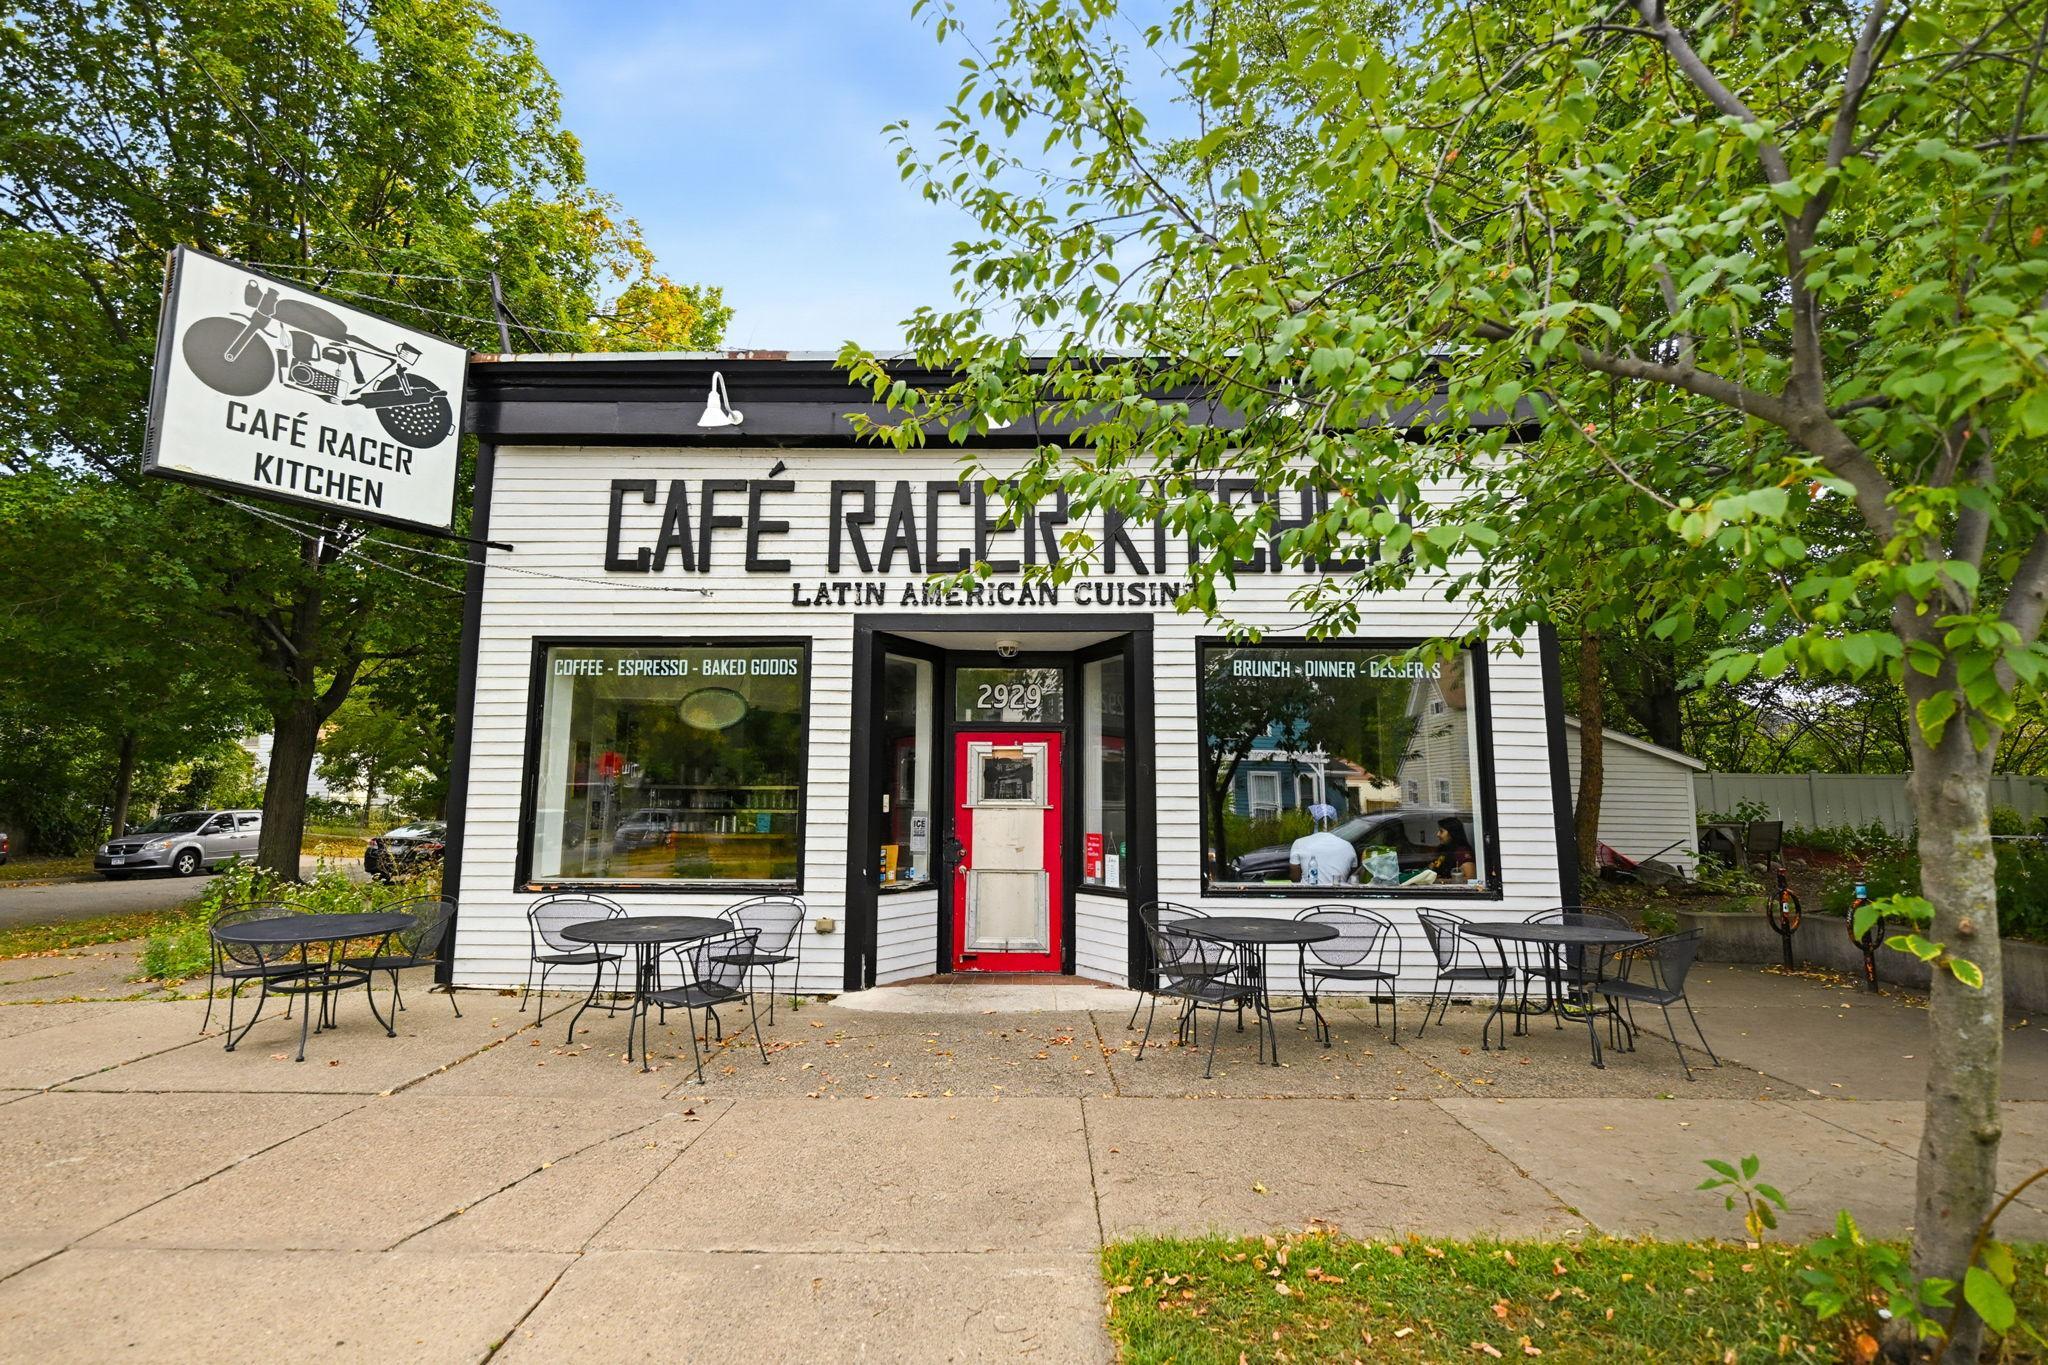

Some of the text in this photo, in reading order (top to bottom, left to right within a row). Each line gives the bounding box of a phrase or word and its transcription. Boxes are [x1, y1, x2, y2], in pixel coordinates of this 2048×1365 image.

[226, 400, 413, 475] CAFÉ RACER
[254, 452, 383, 508] KITCHEN
[604, 460, 796, 573] CAFÉ
[828, 479, 1069, 573] RACER
[792, 582, 1196, 607] LATIN AMERICAN CUISIN
[554, 659, 604, 676] COFFEE
[617, 659, 688, 676] ESPRESSO
[702, 659, 747, 676] BAKED
[751, 658, 798, 676] GOODS
[1233, 659, 1291, 678] BRUNCH
[1305, 660, 1356, 678] DINNER
[977, 683, 1042, 709] 2929
